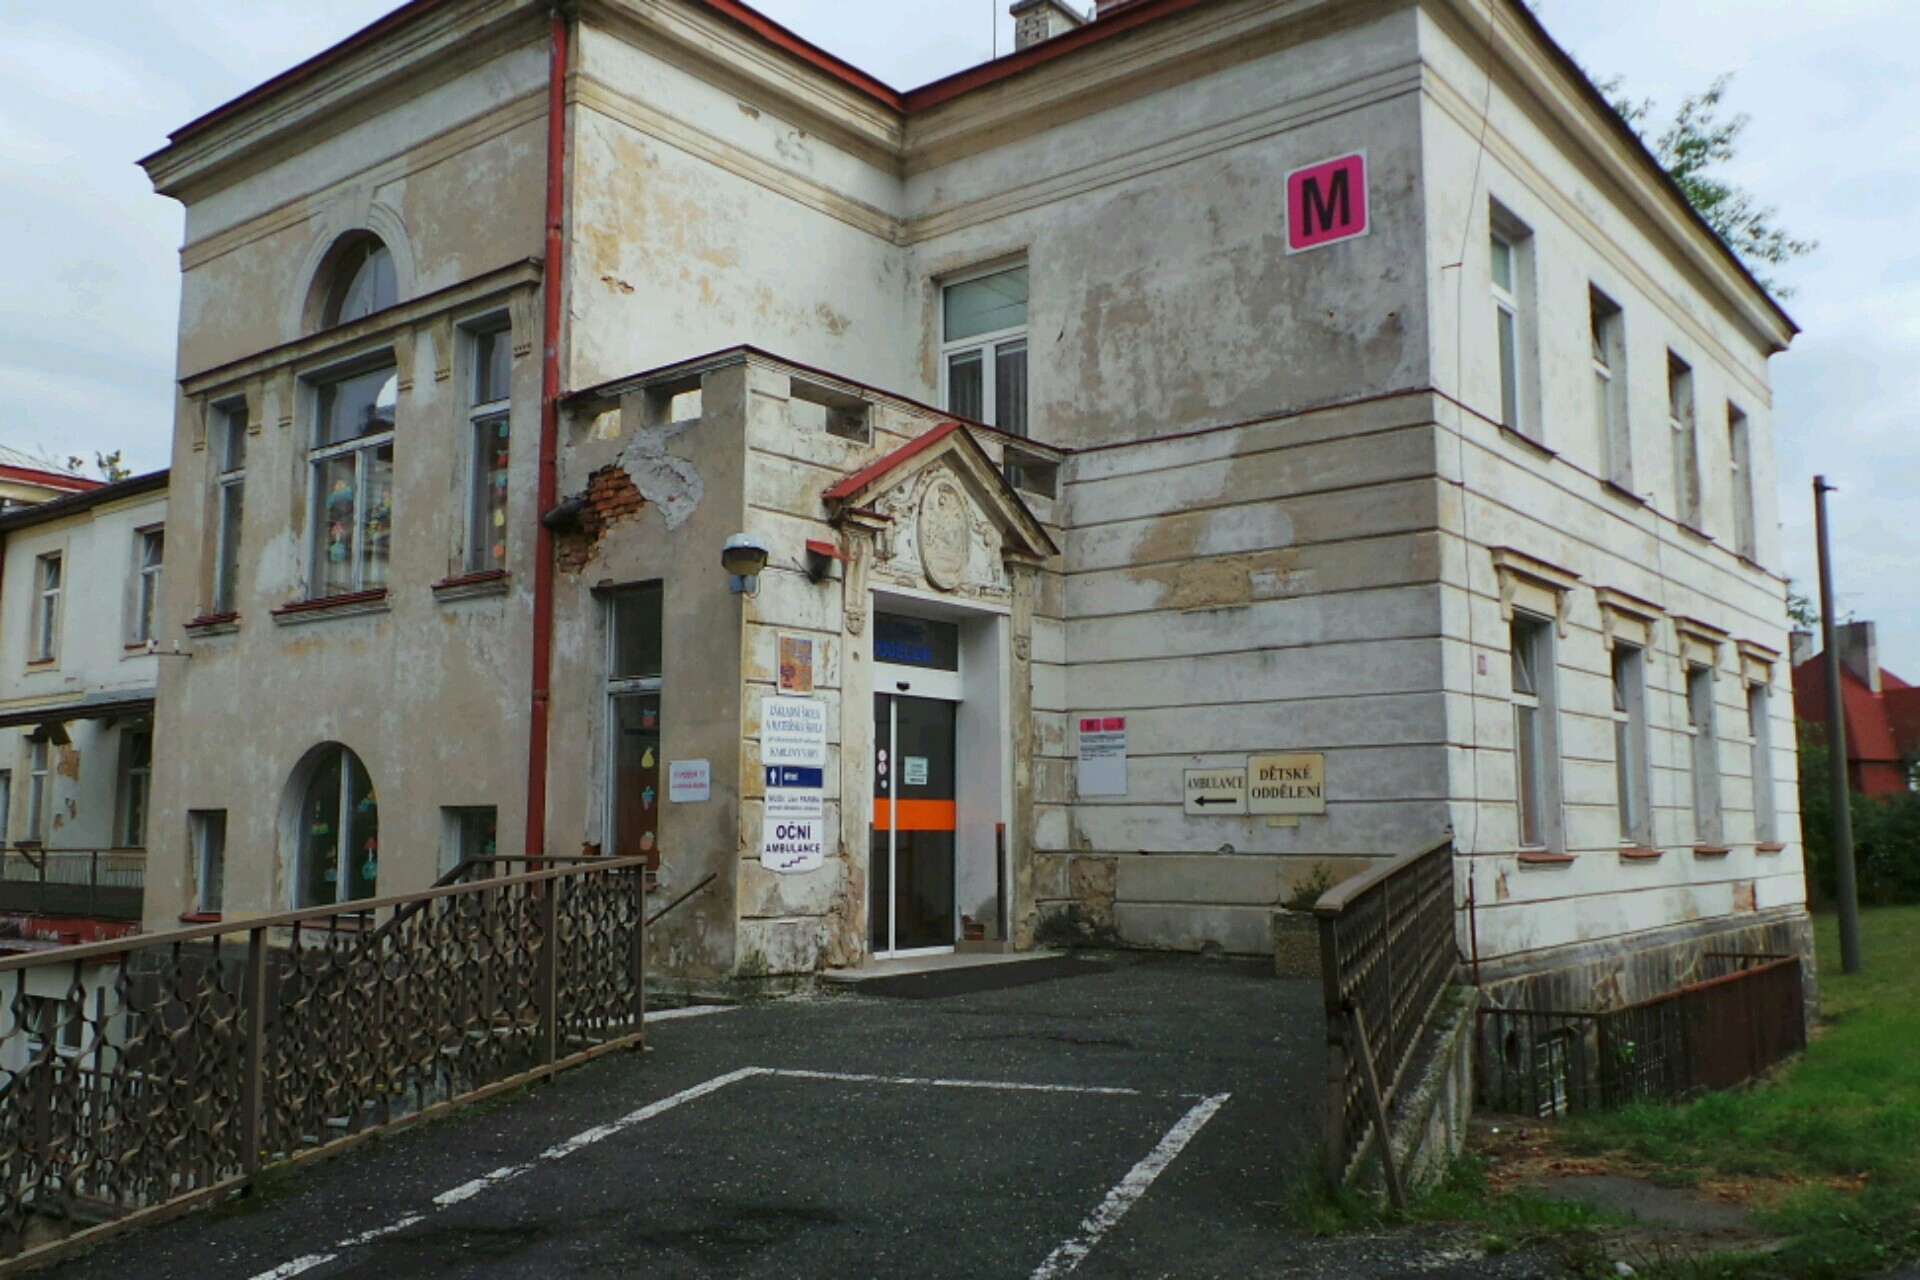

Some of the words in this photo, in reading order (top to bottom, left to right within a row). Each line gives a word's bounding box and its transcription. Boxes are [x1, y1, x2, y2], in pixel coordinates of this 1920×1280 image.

[1302, 168, 1350, 237] M
[1260, 764, 1312, 781] DĚTSKÉ
[1187, 776, 1244, 789] AMBULANCE
[1251, 782, 1320, 799] ODDĚLENÍ
[776, 821, 811, 840] OČNÍ
[766, 843, 820, 854] AMBULANCE
